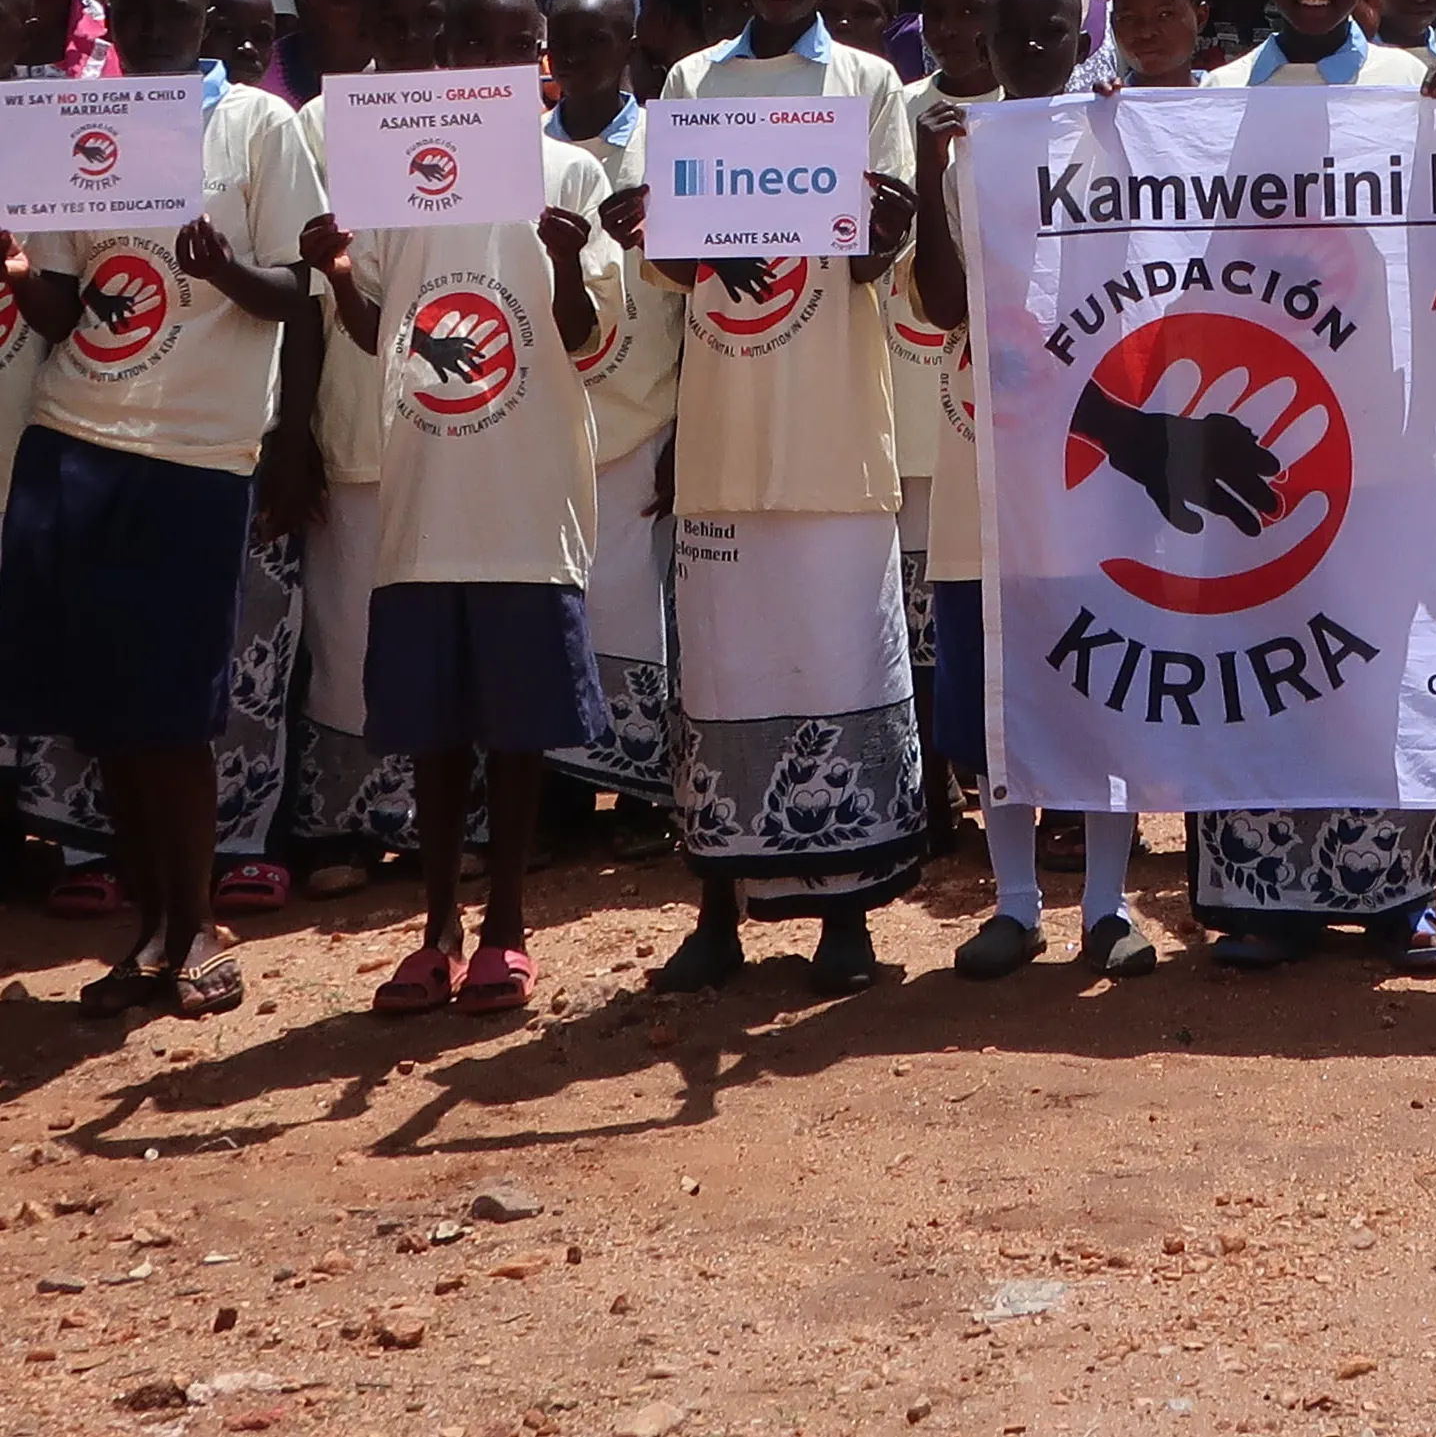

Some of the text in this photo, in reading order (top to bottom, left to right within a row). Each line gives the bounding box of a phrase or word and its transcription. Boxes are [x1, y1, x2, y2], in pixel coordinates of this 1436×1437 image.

[5, 90, 186, 106] WE SAY NO TO FGM & CHILD
[348, 93, 397, 106] THANK
[401, 91, 432, 104] YOU
[446, 85, 513, 101] GRACIAS
[60, 104, 129, 116] MARRIAGE
[671, 114, 720, 126] THANK
[725, 112, 756, 125] YOU
[769, 111, 835, 124] GRACIAS
[379, 113, 482, 130] ASANTE SANA
[69, 173, 122, 191] KIRIRA
[715, 159, 838, 196] ineco
[1037, 155, 1403, 227] Kamwerini
[7, 198, 186, 215] WE SAY YES TO EDUCATION
[407, 192, 463, 212] KIRIRA
[704, 232, 801, 245] ASANTE SANA
[466, 272, 486, 285] THE
[1044, 257, 1358, 366] FUNDACIÓN
[683, 519, 735, 539] Behind
[1044, 605, 1381, 726] KIRIRA
